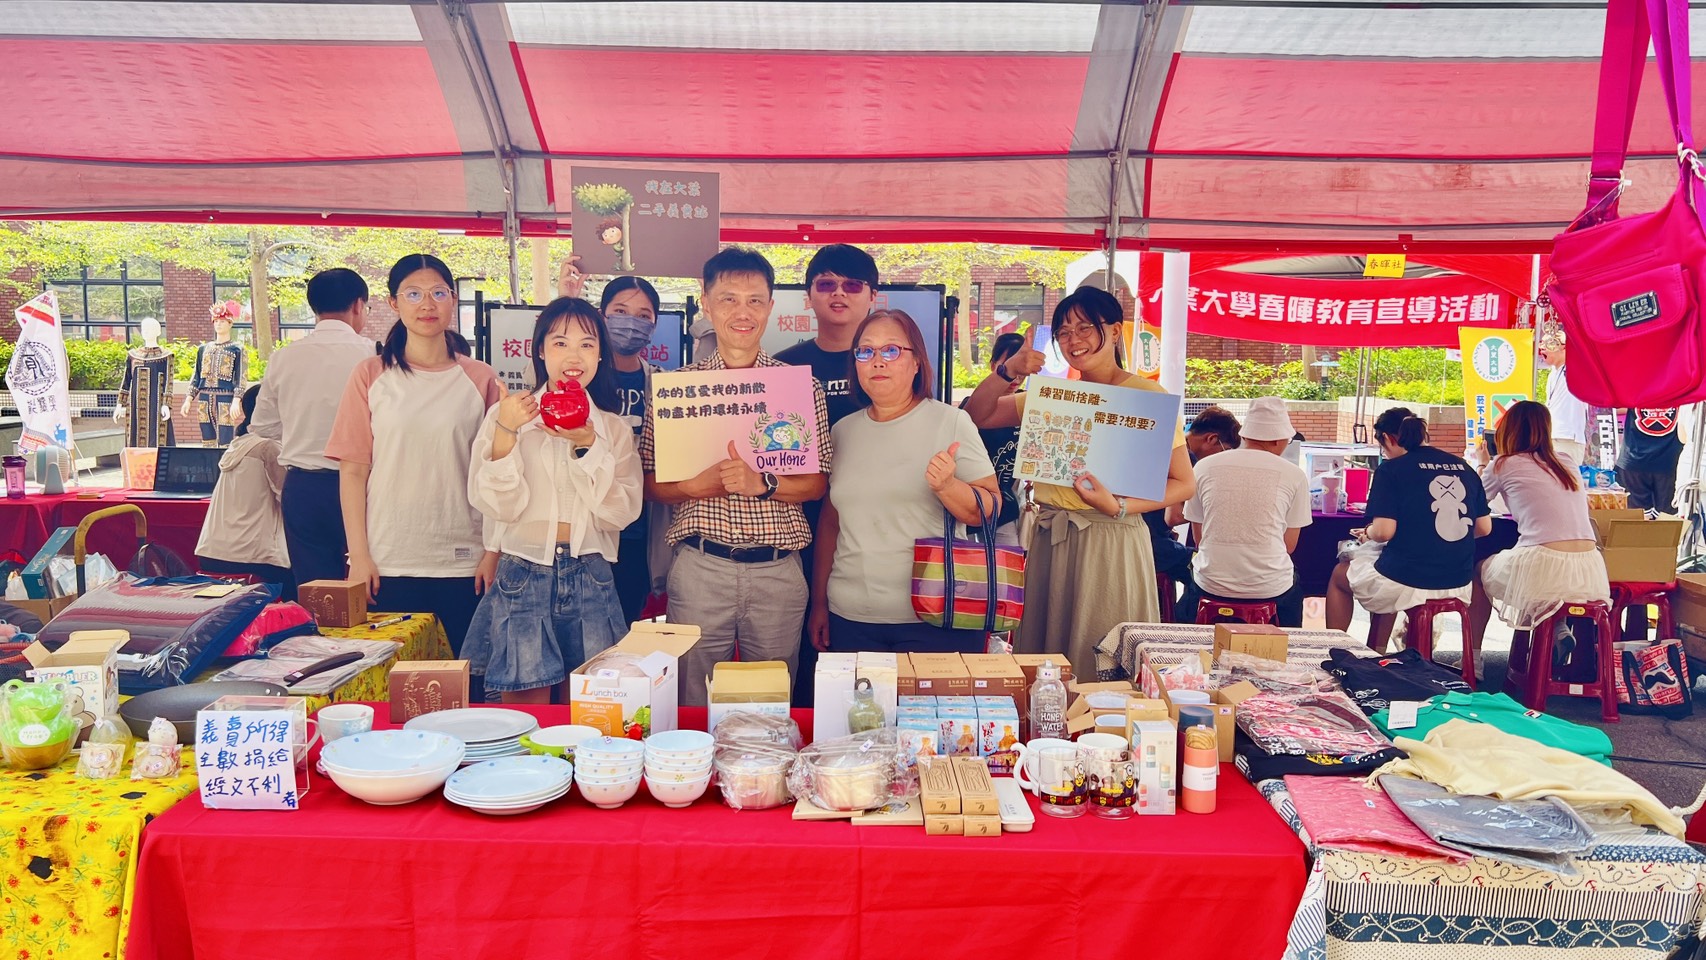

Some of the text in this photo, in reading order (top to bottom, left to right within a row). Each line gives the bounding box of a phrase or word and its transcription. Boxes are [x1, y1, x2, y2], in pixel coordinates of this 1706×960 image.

[645, 180, 701, 197] 我在大葉
[638, 203, 709, 219] 二手義賣站
[1368, 257, 1402, 270] 春暉社
[1149, 286, 1500, 325] 大學春暉教育宣導活動
[656, 382, 766, 400] 你的舊愛我的新歡
[657, 402, 768, 419] 物盡其用環境永續
[1094, 411, 1156, 431] 需要?想要?
[756, 455, 778, 469] Our
[580, 679, 612, 697] Lunch
[1041, 712, 1063, 722] HONEY
[201, 715, 289, 747] 義賣所得
[1042, 721, 1064, 731] WATER
[200, 747, 289, 772] 全數捐給
